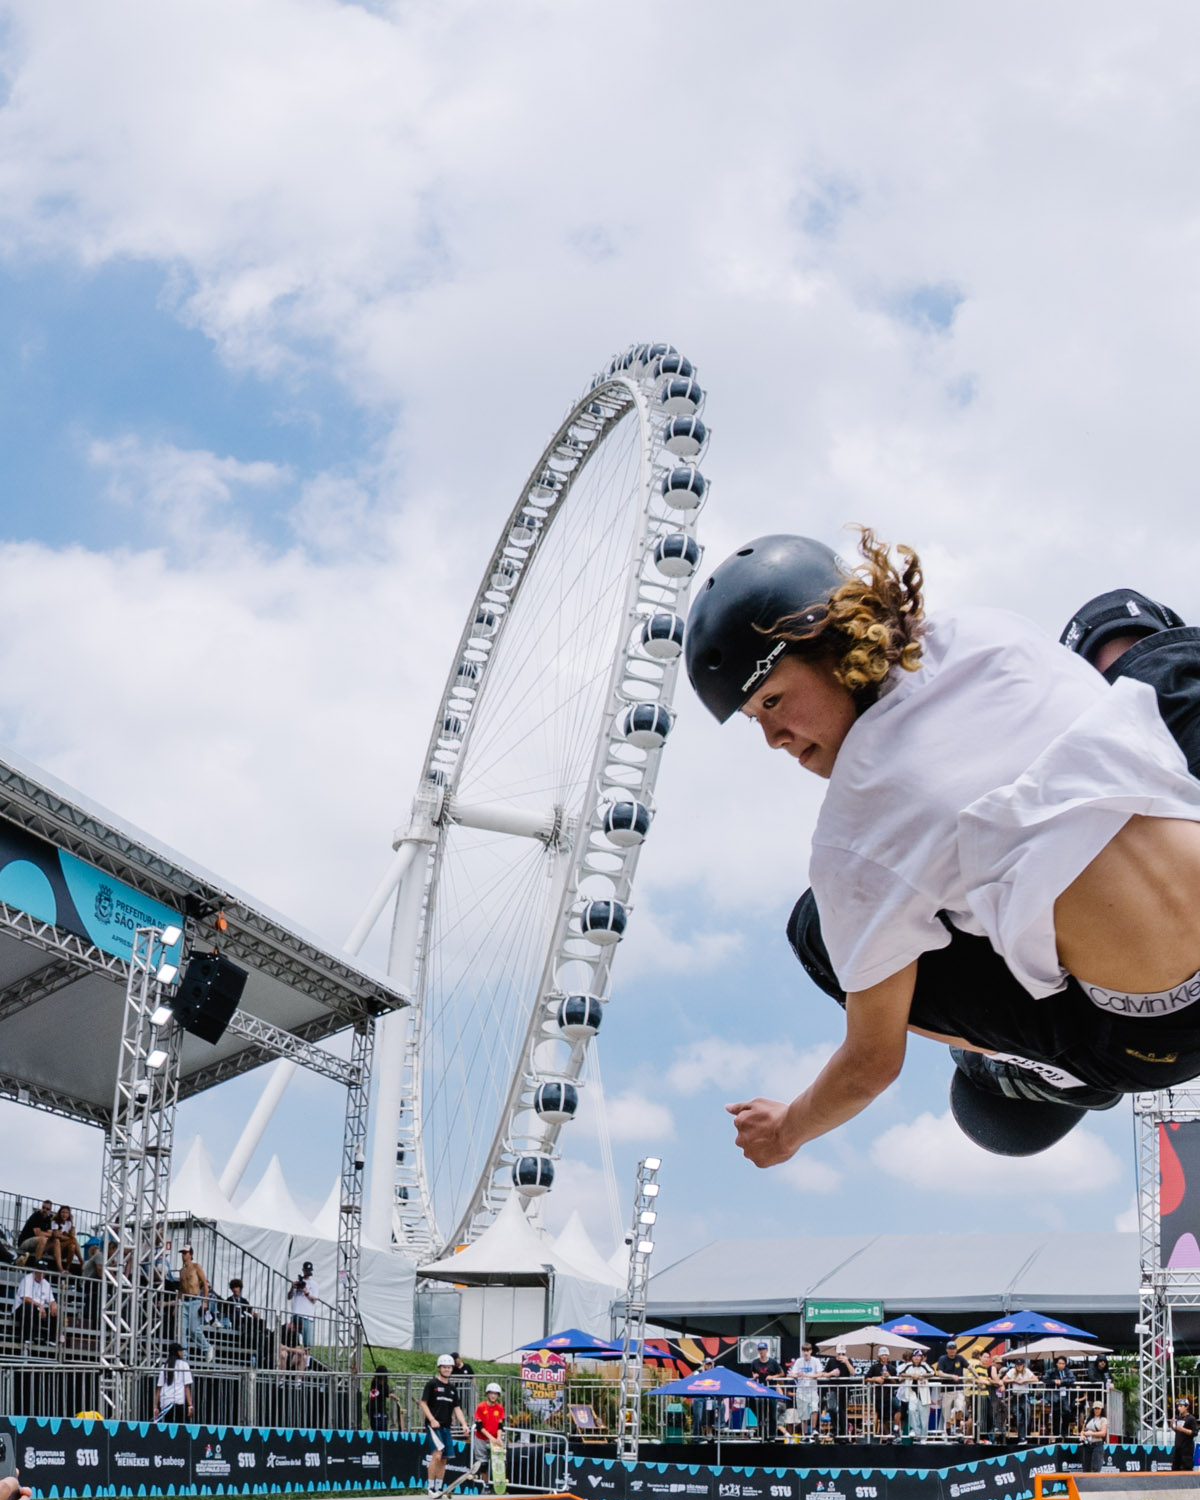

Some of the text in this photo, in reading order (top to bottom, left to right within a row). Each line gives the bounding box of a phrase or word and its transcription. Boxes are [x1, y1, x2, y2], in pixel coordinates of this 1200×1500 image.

[114, 911, 134, 930] SÃO
[115, 900, 156, 926] PREFEITURA
[1089, 987, 1167, 1014] Calvin
[522, 1367, 565, 1382] Red Bull
[526, 1381, 563, 1391] ATHLETE
[532, 1390, 556, 1399] ZONE
[76, 1449, 98, 1466] STU
[117, 1458, 149, 1467] HEINEKEN
[162, 1456, 185, 1467] sabesp
[238, 1452, 256, 1468] STU
[304, 1452, 320, 1467] STU
[1126, 1461, 1140, 1472] STU
[994, 1471, 1016, 1486] STU
[770, 1485, 792, 1497] STU
[855, 1486, 877, 1498] STU
